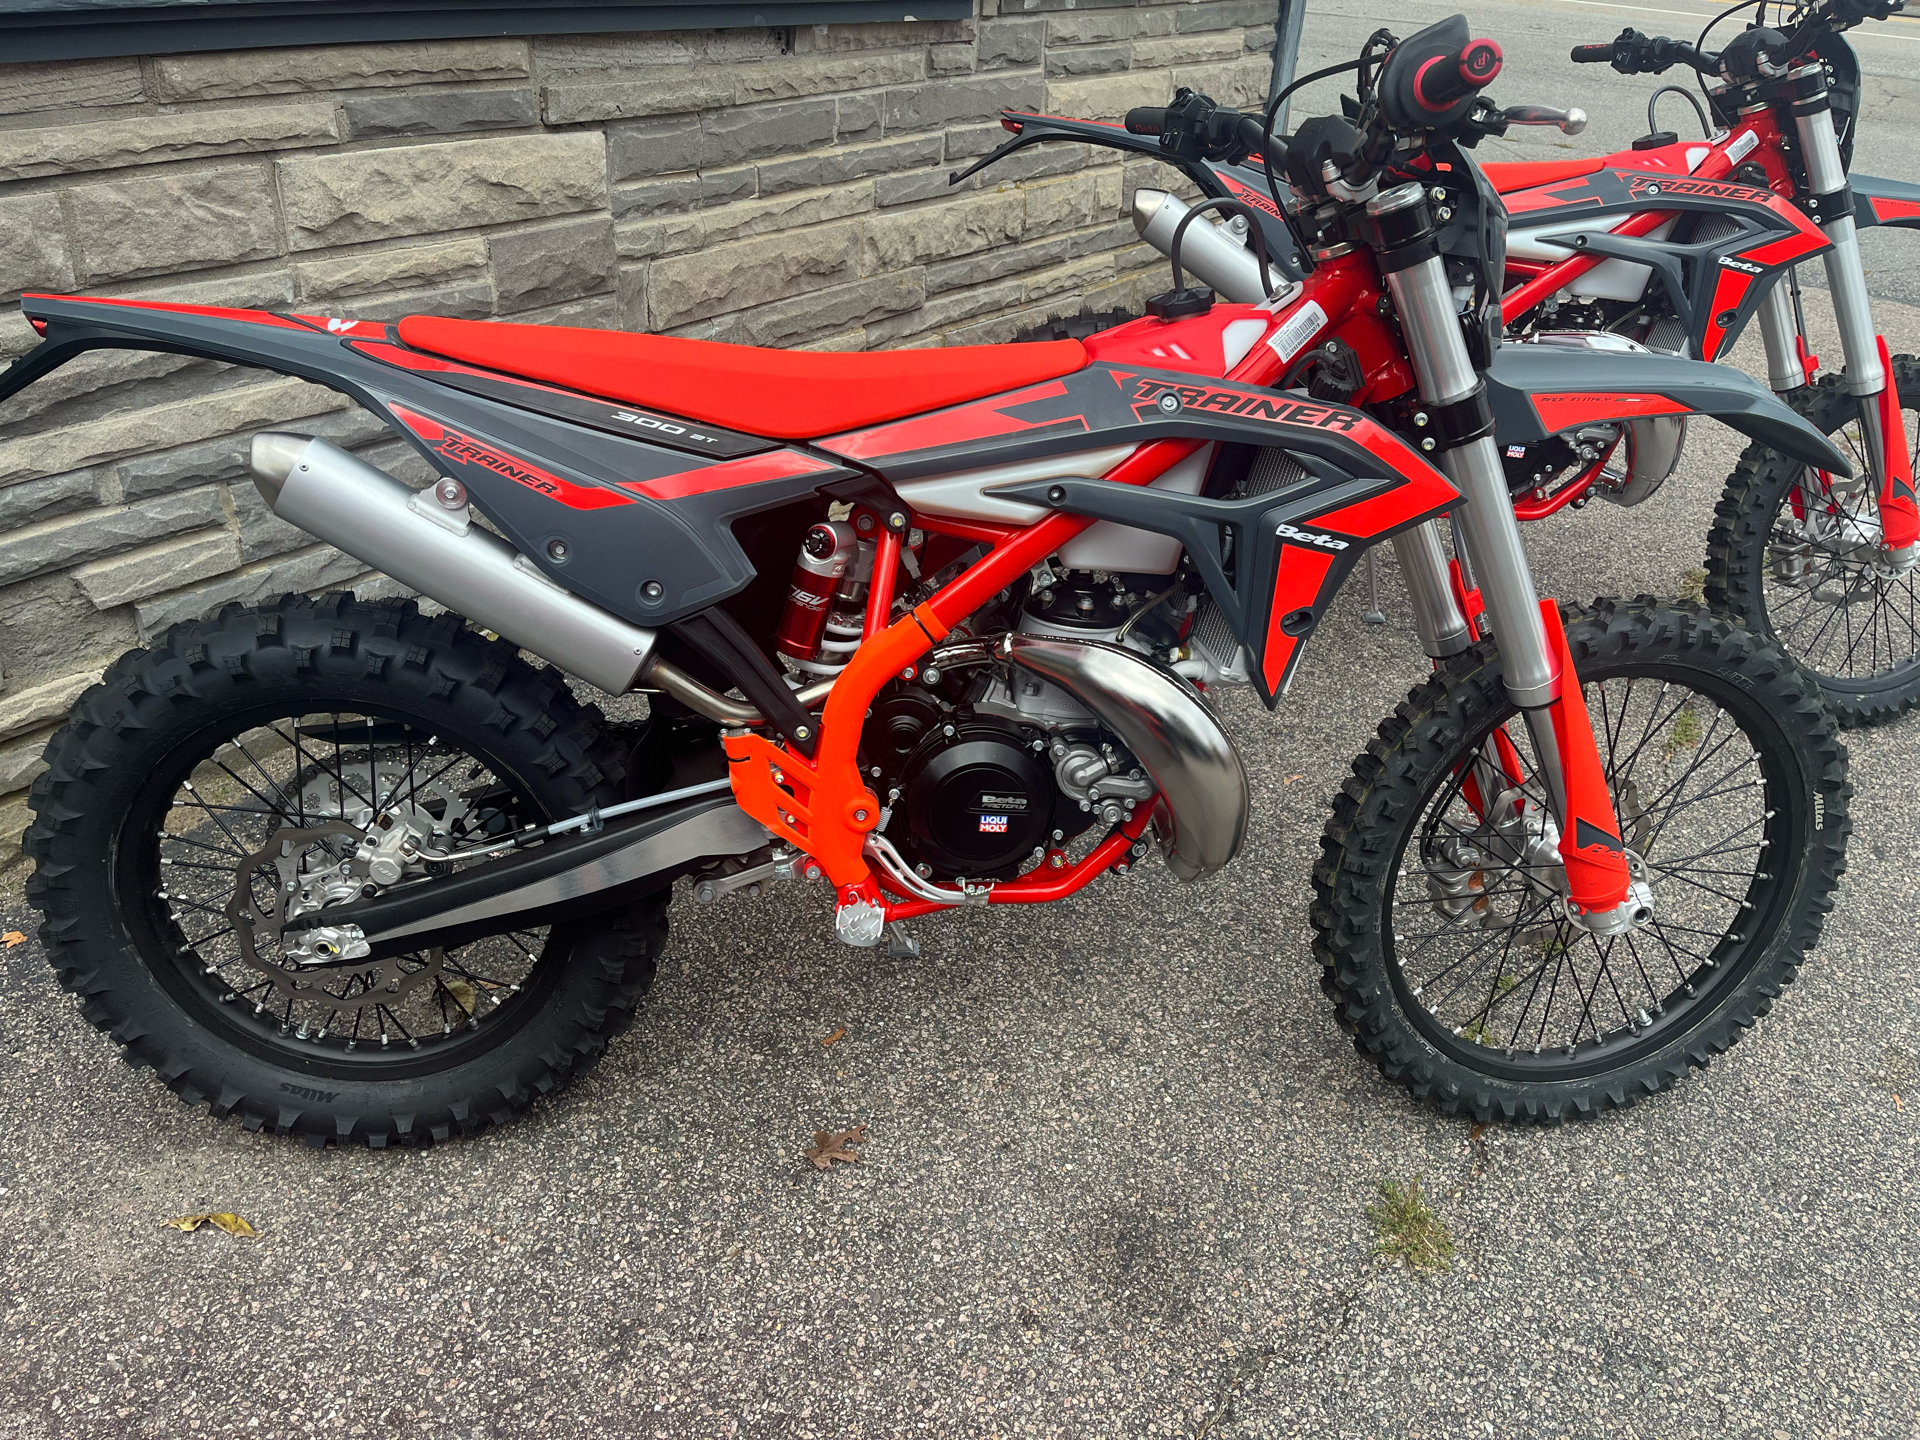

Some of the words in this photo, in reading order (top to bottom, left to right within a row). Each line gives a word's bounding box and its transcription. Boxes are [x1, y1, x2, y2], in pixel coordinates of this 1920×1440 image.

[1632, 176, 1775, 203] TRAINER
[1241, 190, 1283, 219] TRAIN
[1717, 255, 1764, 274] Beta
[1137, 380, 1363, 432] TRAINER
[611, 411, 687, 435] 300
[689, 433, 719, 443] 2T
[1508, 444, 1526, 453] LIQUI
[445, 437, 558, 494] TRAINER
[1275, 523, 1350, 551] Beta
[981, 794, 1028, 805] Beta
[1812, 790, 1825, 831] Mitas
[979, 824, 1007, 833] MOLY
[981, 815, 1008, 825] LIQUI
[278, 1082, 341, 1104] Mitas
